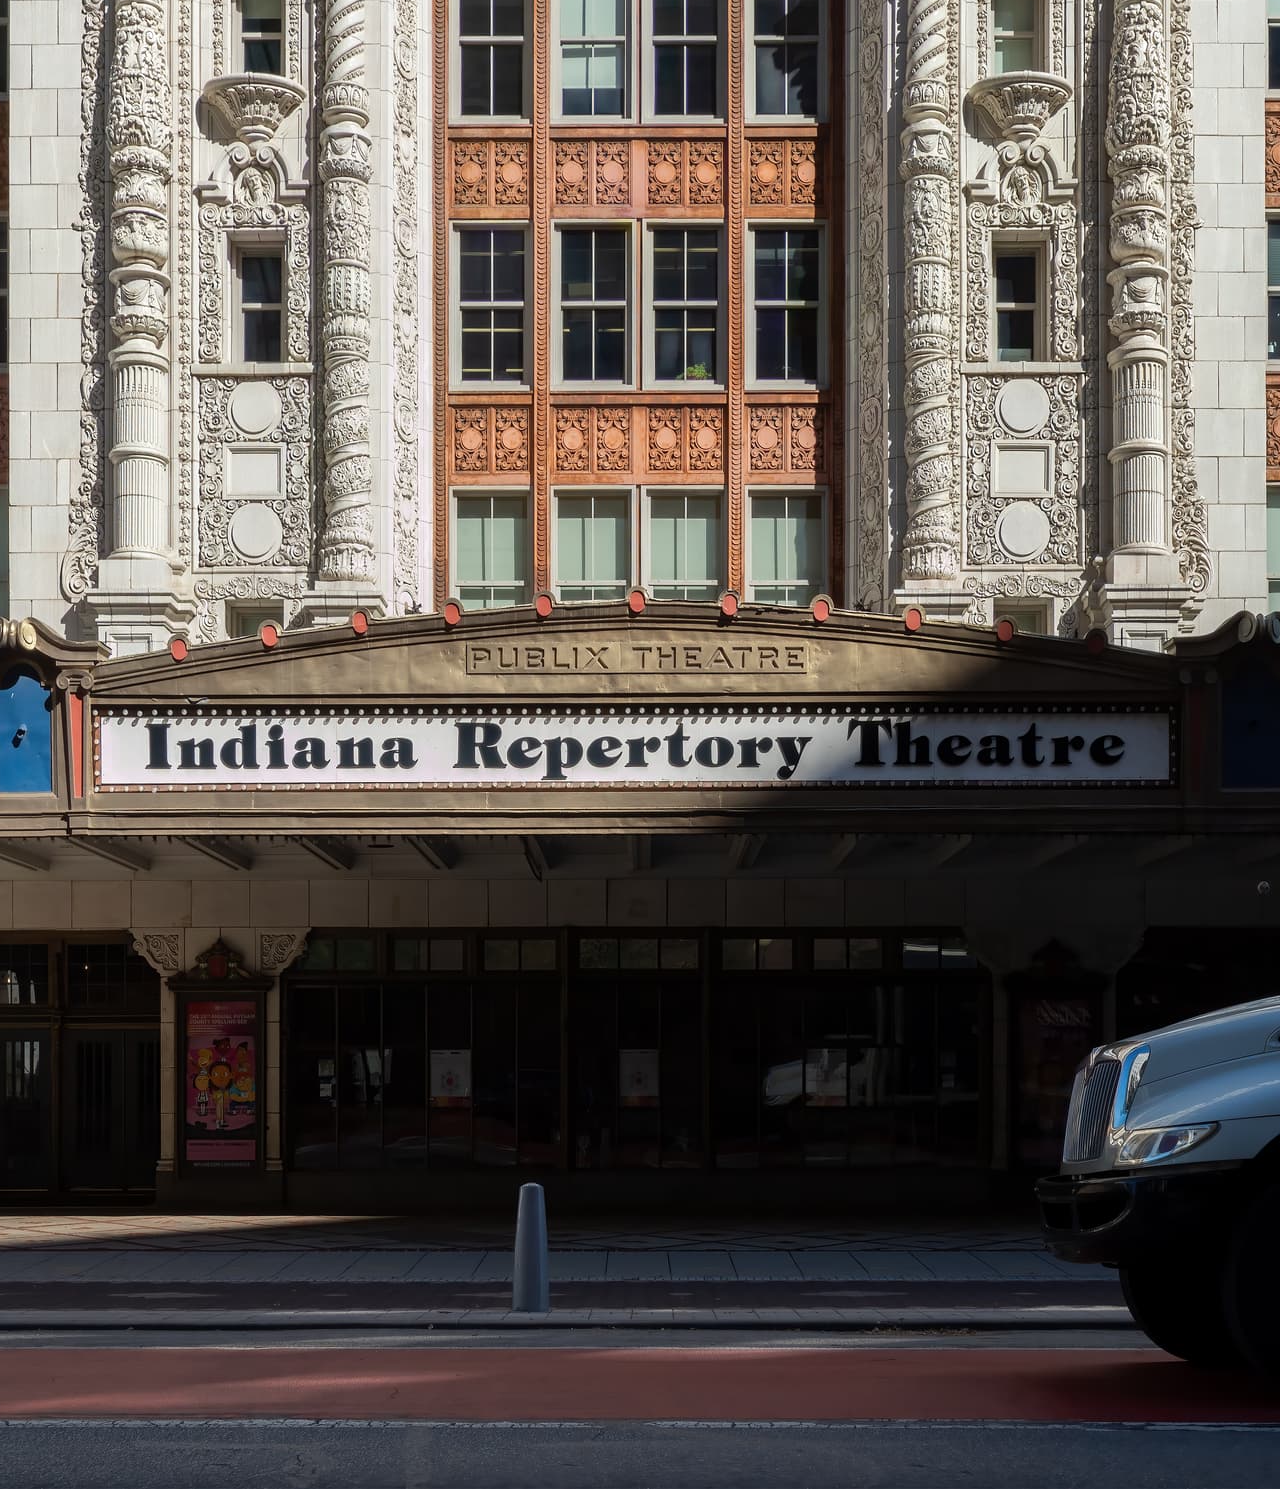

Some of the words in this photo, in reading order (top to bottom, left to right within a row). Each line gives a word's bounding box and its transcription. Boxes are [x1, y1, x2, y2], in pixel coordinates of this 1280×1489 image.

[470, 645, 608, 672] PUBLIX
[632, 645, 806, 672] THEATRE
[145, 722, 416, 770] Indiana
[454, 721, 813, 781] Repertory
[848, 718, 1127, 768] Theatre
